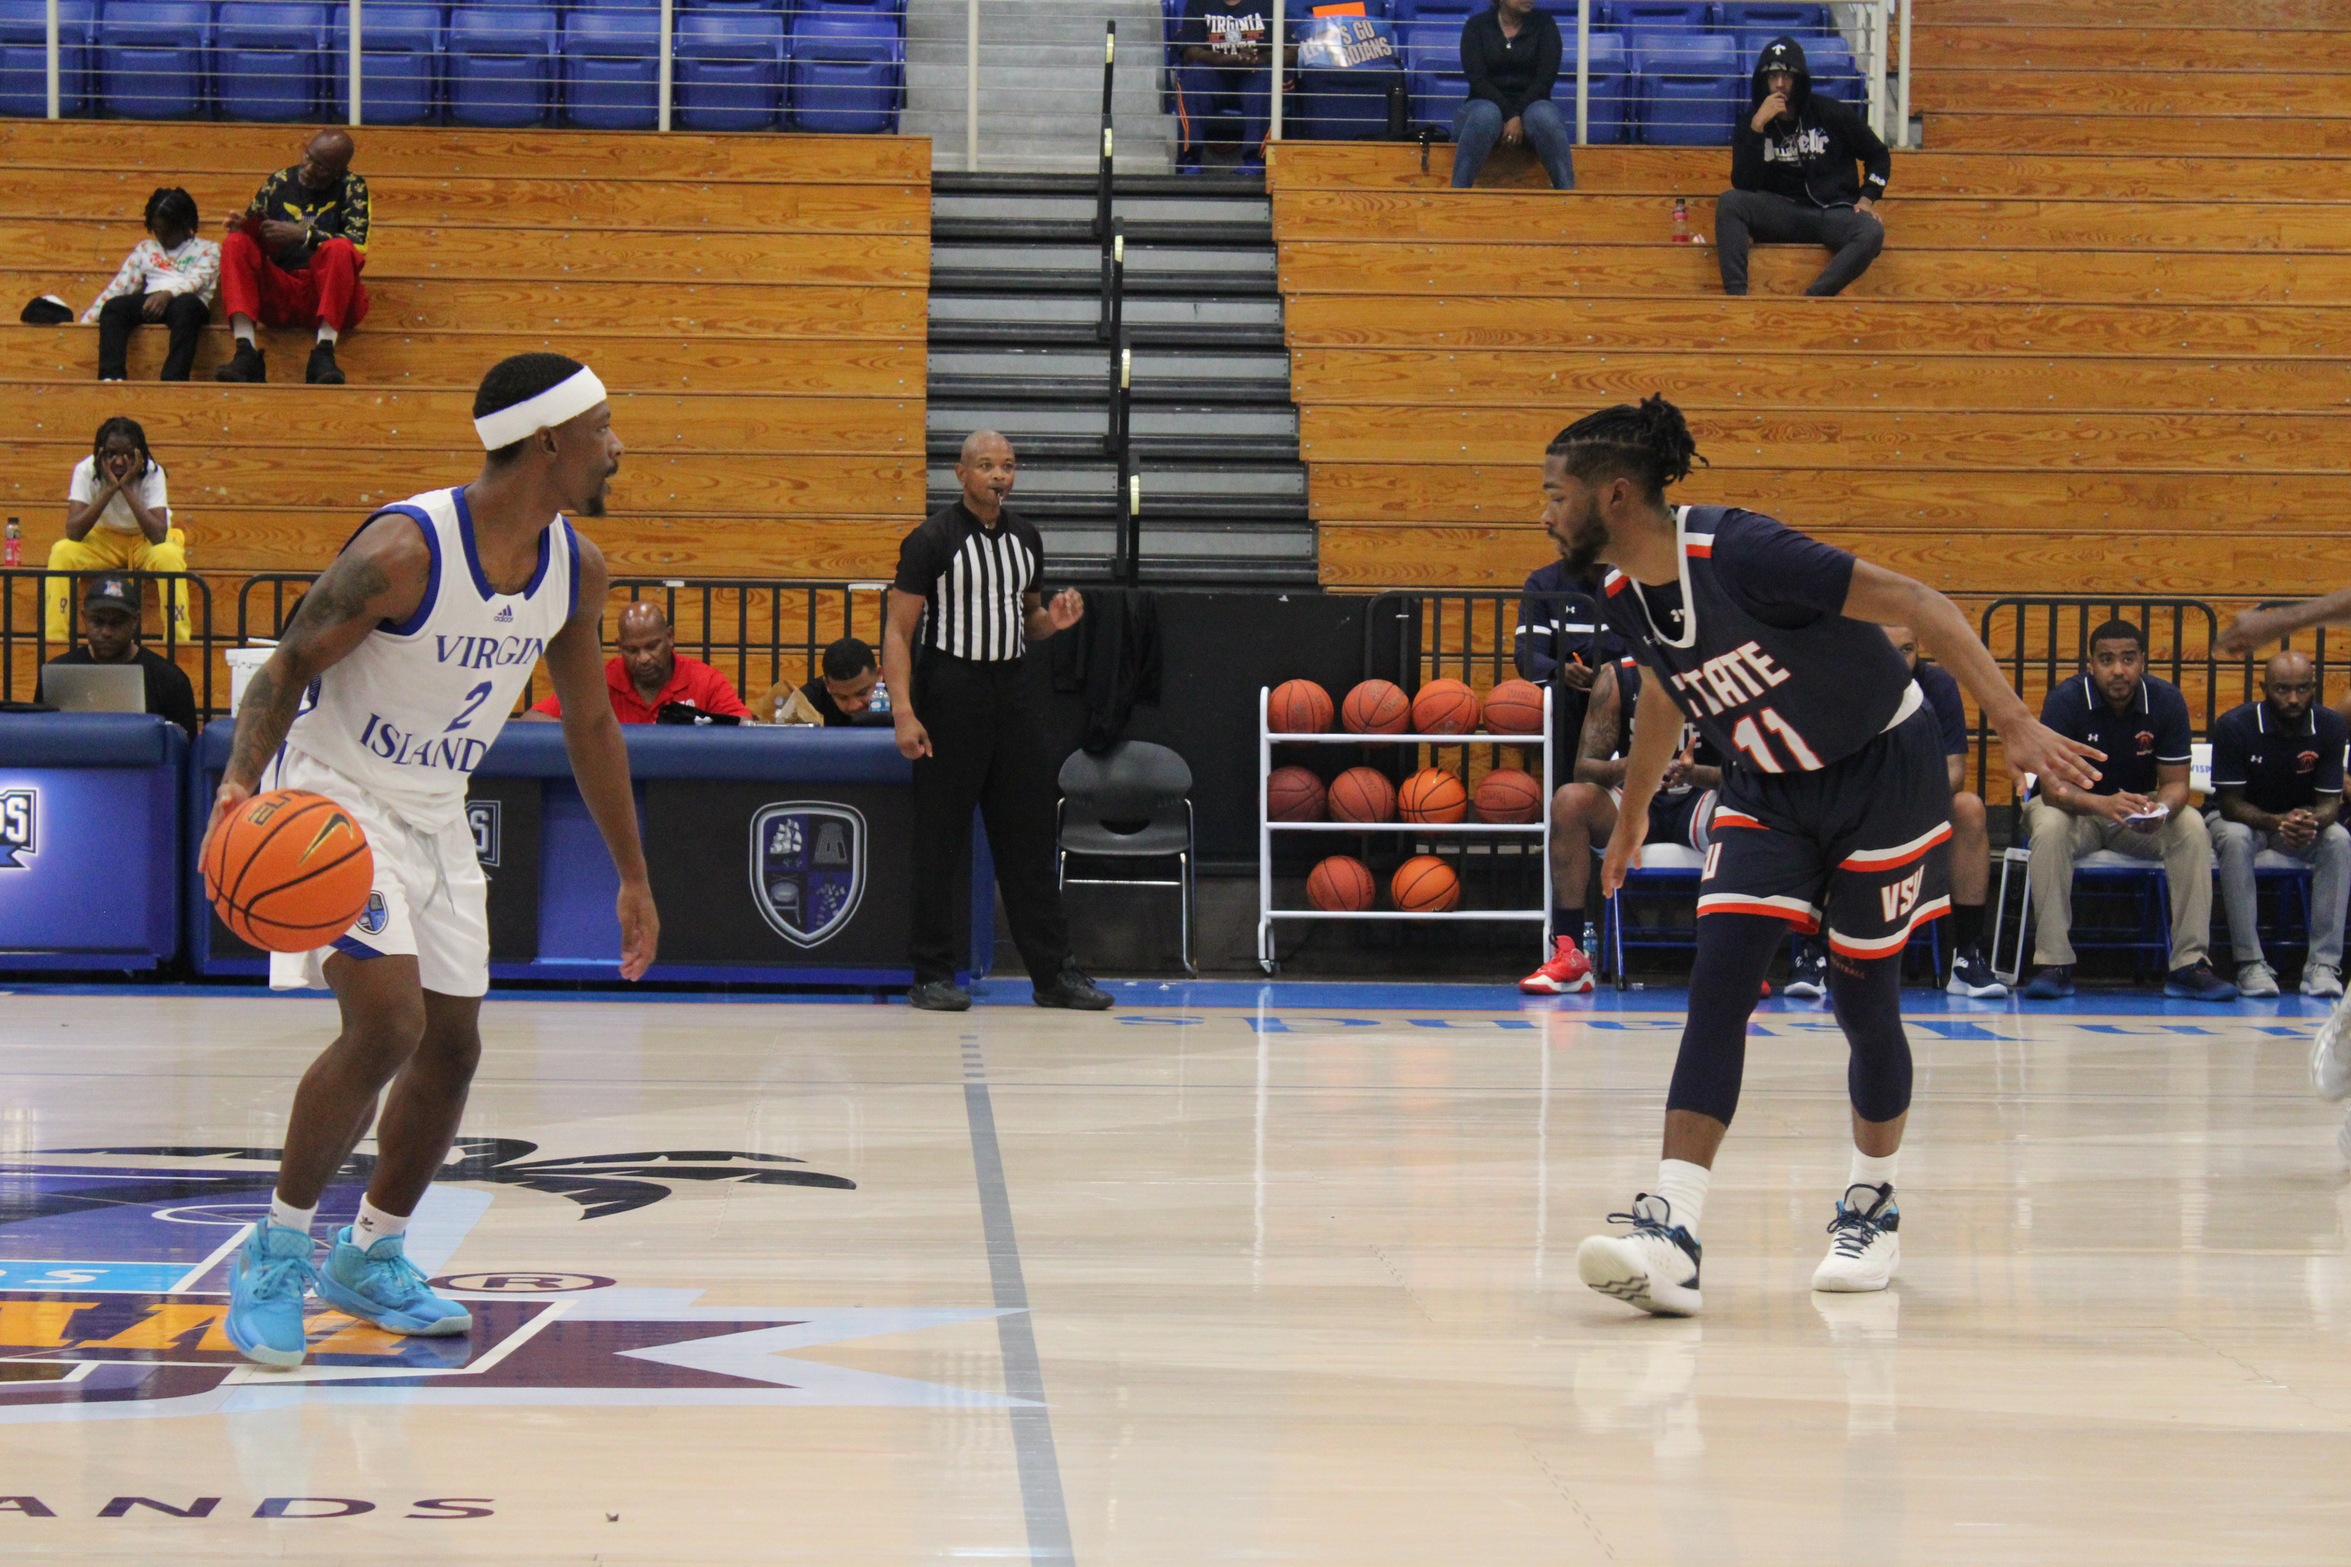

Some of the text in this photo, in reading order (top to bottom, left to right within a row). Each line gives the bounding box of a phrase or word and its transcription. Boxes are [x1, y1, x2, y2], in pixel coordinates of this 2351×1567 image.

[1204, 12, 1266, 33] VIRGINIA
[1352, 19, 1376, 41] GO
[435, 634, 544, 669] VIRGIN
[443, 680, 493, 733] 2
[1732, 706, 1826, 774] 11
[1881, 864, 1925, 923] VSU
